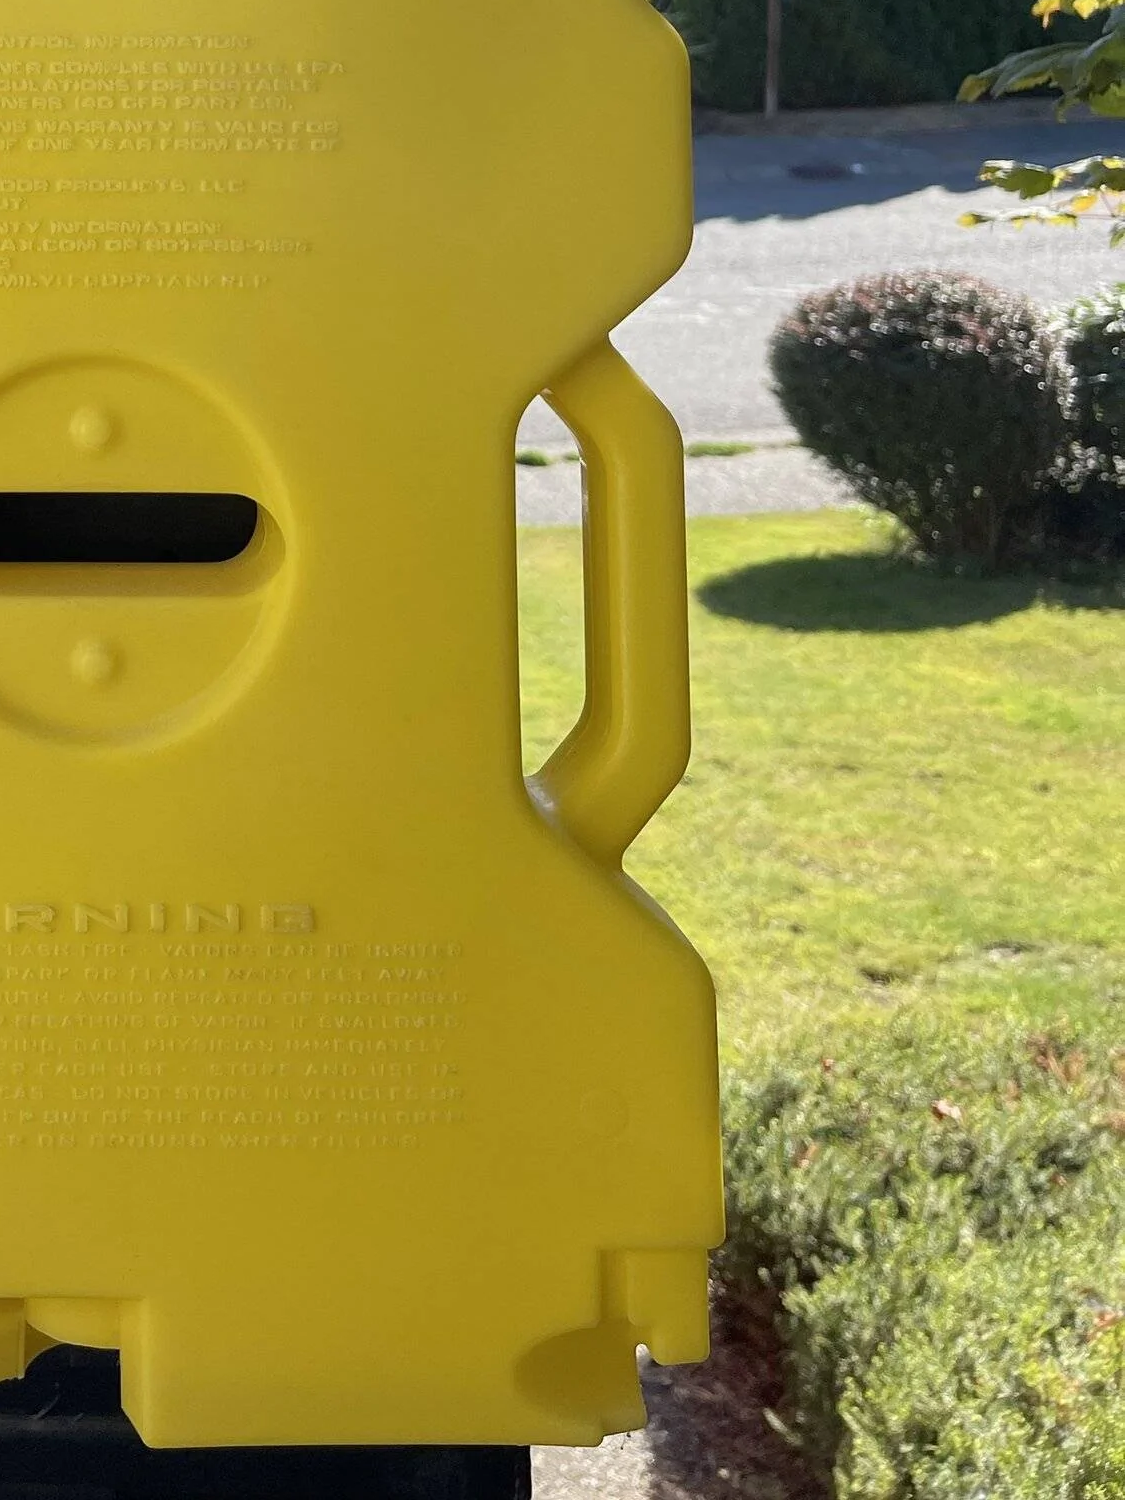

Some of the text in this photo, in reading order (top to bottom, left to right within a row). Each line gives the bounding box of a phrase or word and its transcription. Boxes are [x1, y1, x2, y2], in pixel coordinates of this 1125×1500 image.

[137, 78, 185, 93] FOR
[175, 96, 239, 111] PART
[35, 120, 173, 134] WARRANTY
[215, 120, 284, 134] VALID
[291, 120, 341, 134] FOR
[27, 137, 74, 152] ONE
[85, 137, 152, 152] YEAR
[159, 137, 228, 152] FROM
[236, 137, 302, 152] DATE
